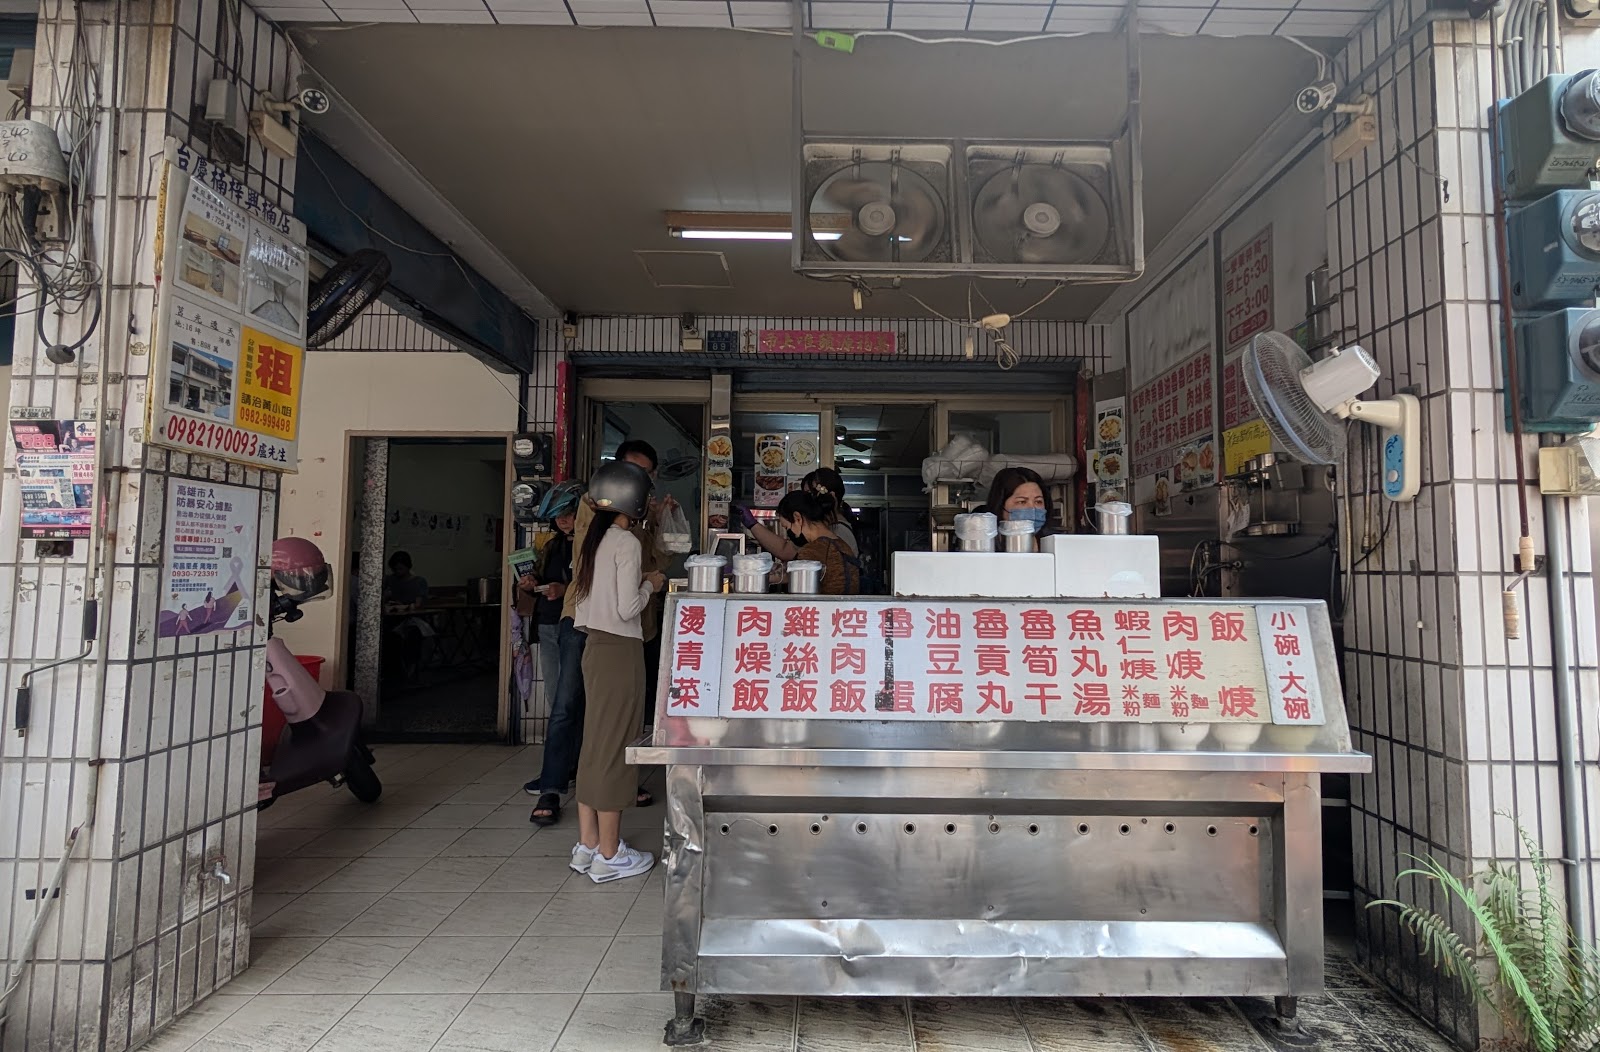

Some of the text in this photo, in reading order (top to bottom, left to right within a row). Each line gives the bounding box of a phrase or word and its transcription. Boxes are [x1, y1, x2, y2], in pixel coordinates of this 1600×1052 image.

[256, 344, 293, 396] 租
[712, 342, 726, 351] 89
[167, 415, 258, 457] 0982190093
[240, 406, 291, 433] 0982-999498
[241, 392, 292, 418] 請洽黃小姐
[176, 484, 207, 499] 高雄市
[257, 443, 287, 462] 盧先生
[176, 496, 233, 512] 防暴安心據點
[671, 605, 707, 709] 燙青菜
[732, 606, 772, 712] 肉燥飯
[780, 606, 820, 712] 雞絲飯
[829, 607, 868, 713] 焢肉飯
[926, 607, 964, 715] 油豆腐
[972, 608, 1013, 715] 魯貢丸
[1019, 609, 1062, 716] 魯筍干
[1066, 609, 1111, 717] 魚丸湯
